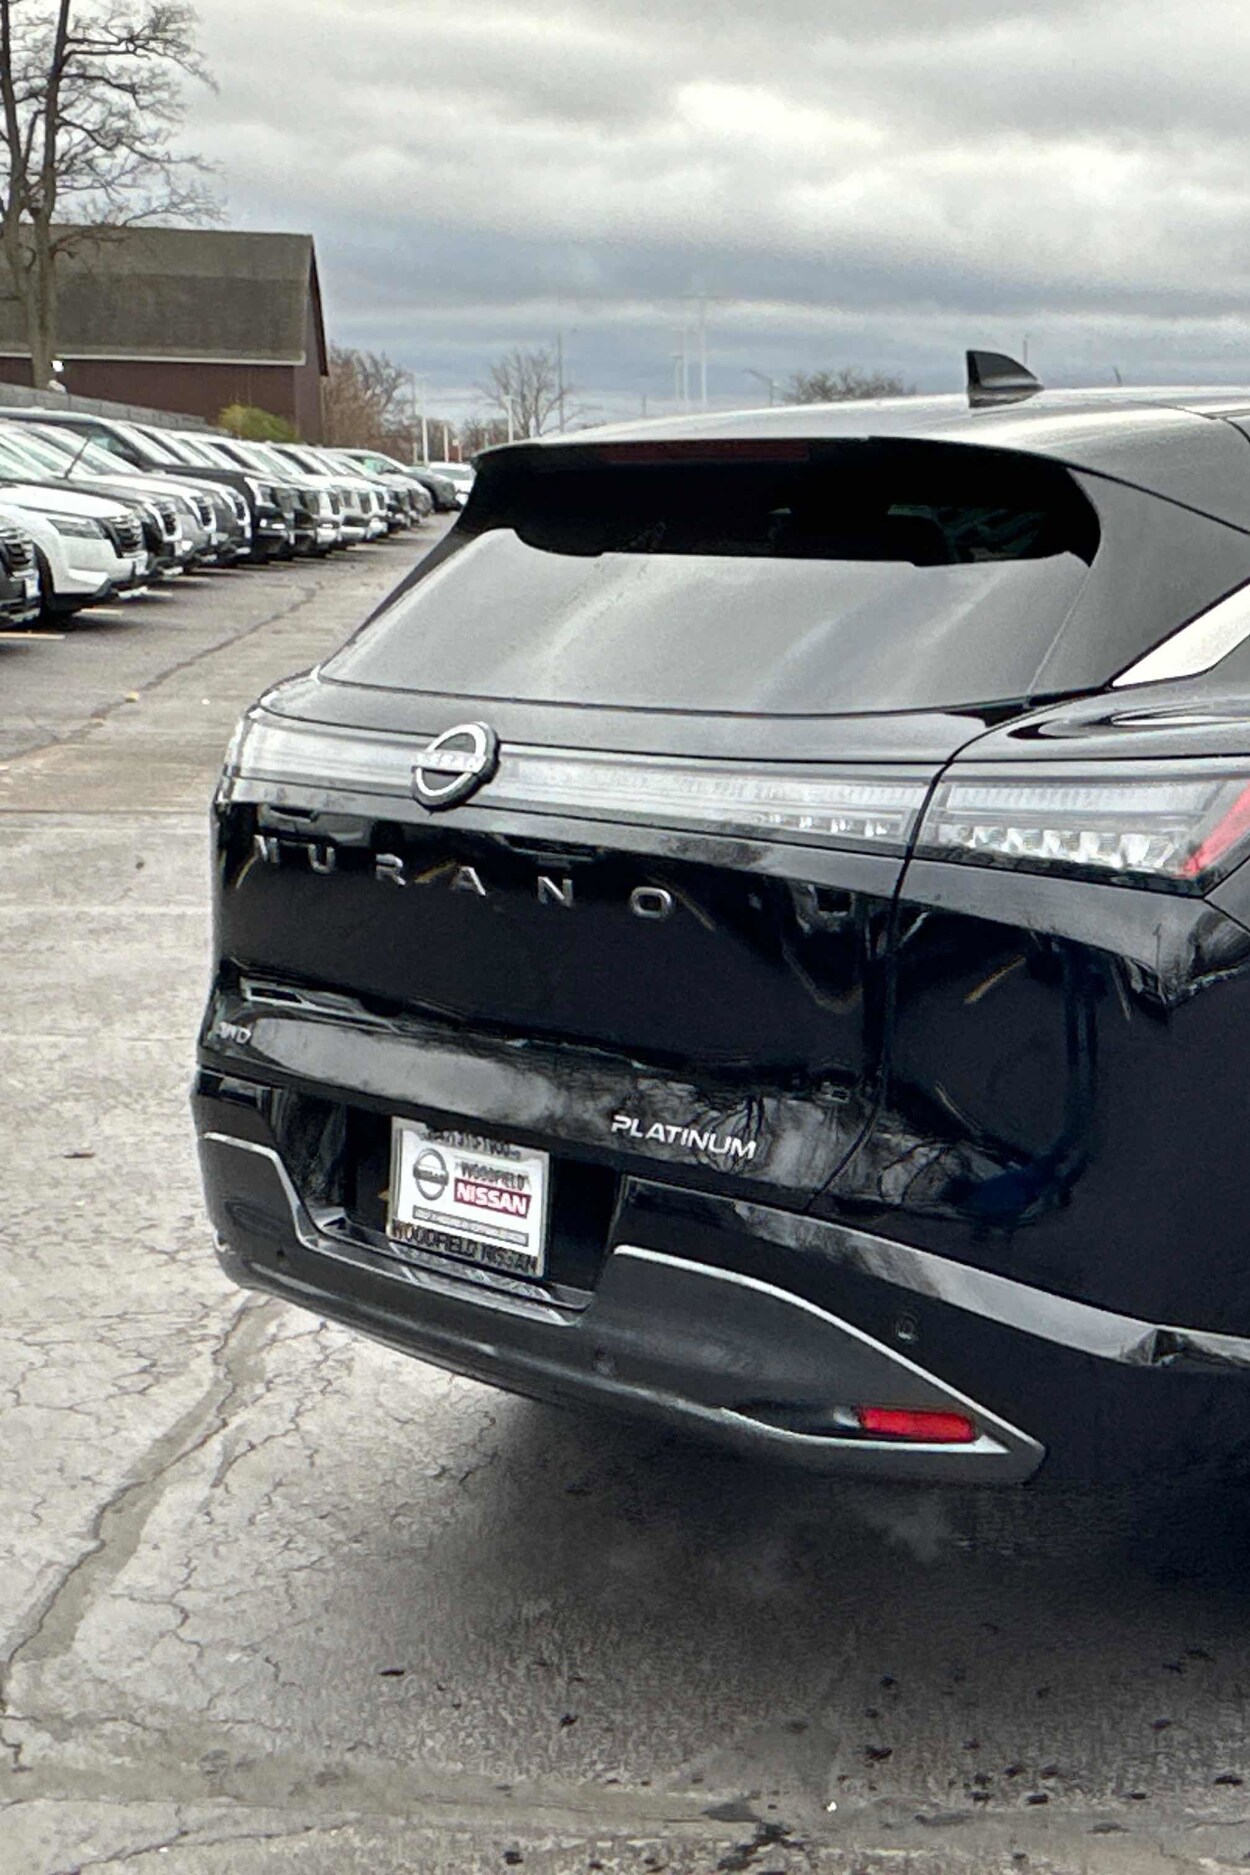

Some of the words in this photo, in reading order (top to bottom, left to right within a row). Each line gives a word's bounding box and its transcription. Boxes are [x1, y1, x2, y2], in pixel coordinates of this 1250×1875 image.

[253, 834, 674, 920] MURANO
[611, 1114, 756, 1159] PLATINUM
[456, 1182, 527, 1215] NISSAN
[480, 1244, 538, 1276] NISSAN
